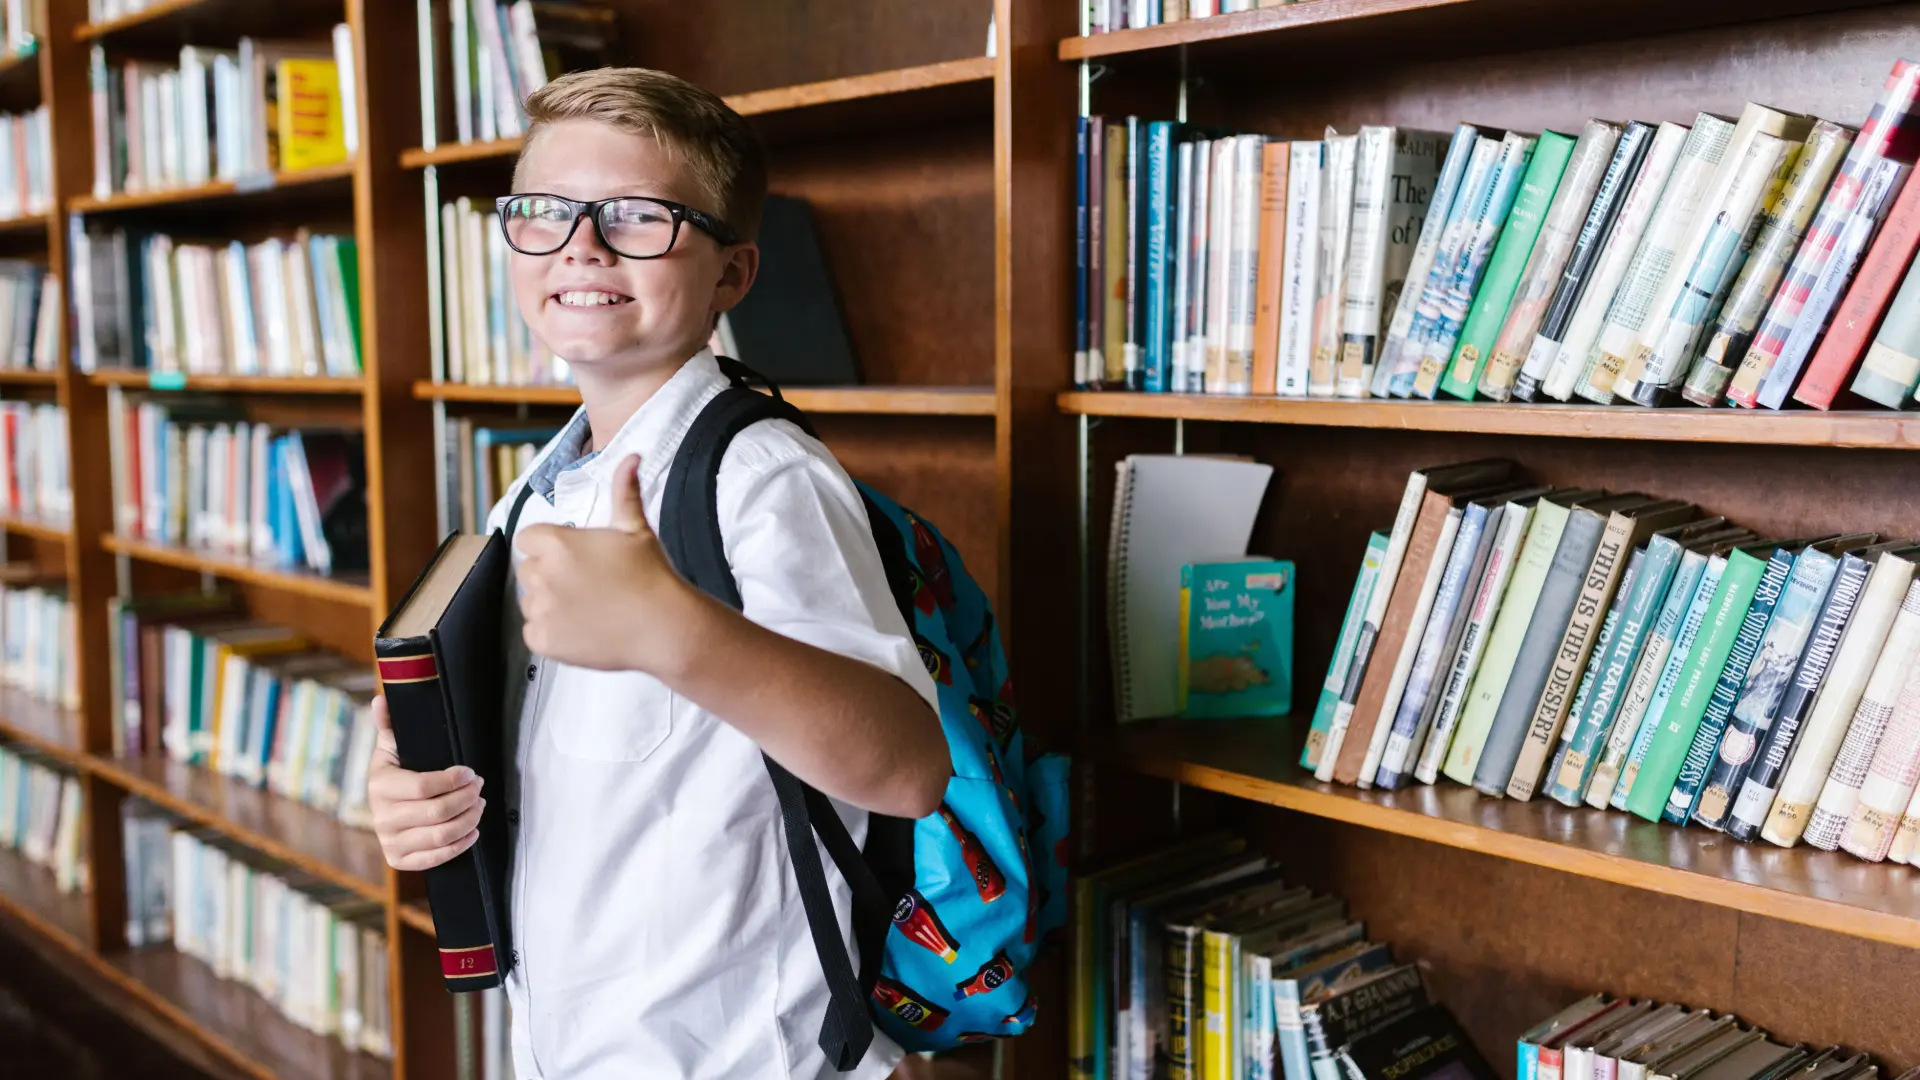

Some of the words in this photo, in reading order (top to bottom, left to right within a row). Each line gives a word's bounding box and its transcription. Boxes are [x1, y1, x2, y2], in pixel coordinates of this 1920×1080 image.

[1499, 141, 1513, 164] THE
[1391, 173, 1427, 205] The
[1391, 215, 1415, 245] of
[1822, 254, 1846, 292] McDaniel
[1602, 362, 1620, 375] MUS
[1607, 356, 1619, 367] FIC
[1585, 538, 1620, 593] THIS
[1753, 556, 1791, 607] MYERS
[1615, 566, 1634, 601] MOOSER
[1696, 574, 1720, 605] THE
[1822, 562, 1867, 627] VIRGINIA
[1576, 592, 1600, 619] IS
[1713, 581, 1739, 626] MACDONALD
[1558, 618, 1590, 664] THE
[1597, 607, 1620, 644] INTO
[1613, 618, 1640, 660] HILL
[1645, 606, 1680, 662] Mystery
[1677, 607, 1705, 652] THREE
[1585, 642, 1607, 673] THE
[1696, 645, 1711, 667] LOST
[1718, 606, 1769, 688] SOMEWHERE
[1794, 619, 1841, 693] HAMILTON
[1635, 673, 1652, 693] the
[1642, 659, 1657, 675] at
[1586, 660, 1623, 727] RANCH
[1678, 668, 1702, 708] PRINCESS
[1712, 683, 1737, 703] IN
[1527, 664, 1574, 745] DESERT
[1615, 690, 1646, 738] Pilgrim
[1702, 698, 1730, 726] THE
[1772, 714, 1800, 748] PLAIN
[1676, 720, 1721, 788] DARKNESS
[1762, 743, 1787, 771] CITY
[1782, 802, 1796, 813] FIC
[1862, 815, 1884, 831] MAY
[1866, 809, 1883, 820] FIC
[1902, 815, 1917, 826] FIC
[894, 901, 912, 920] SUPER
[460, 957, 474, 970] 12
